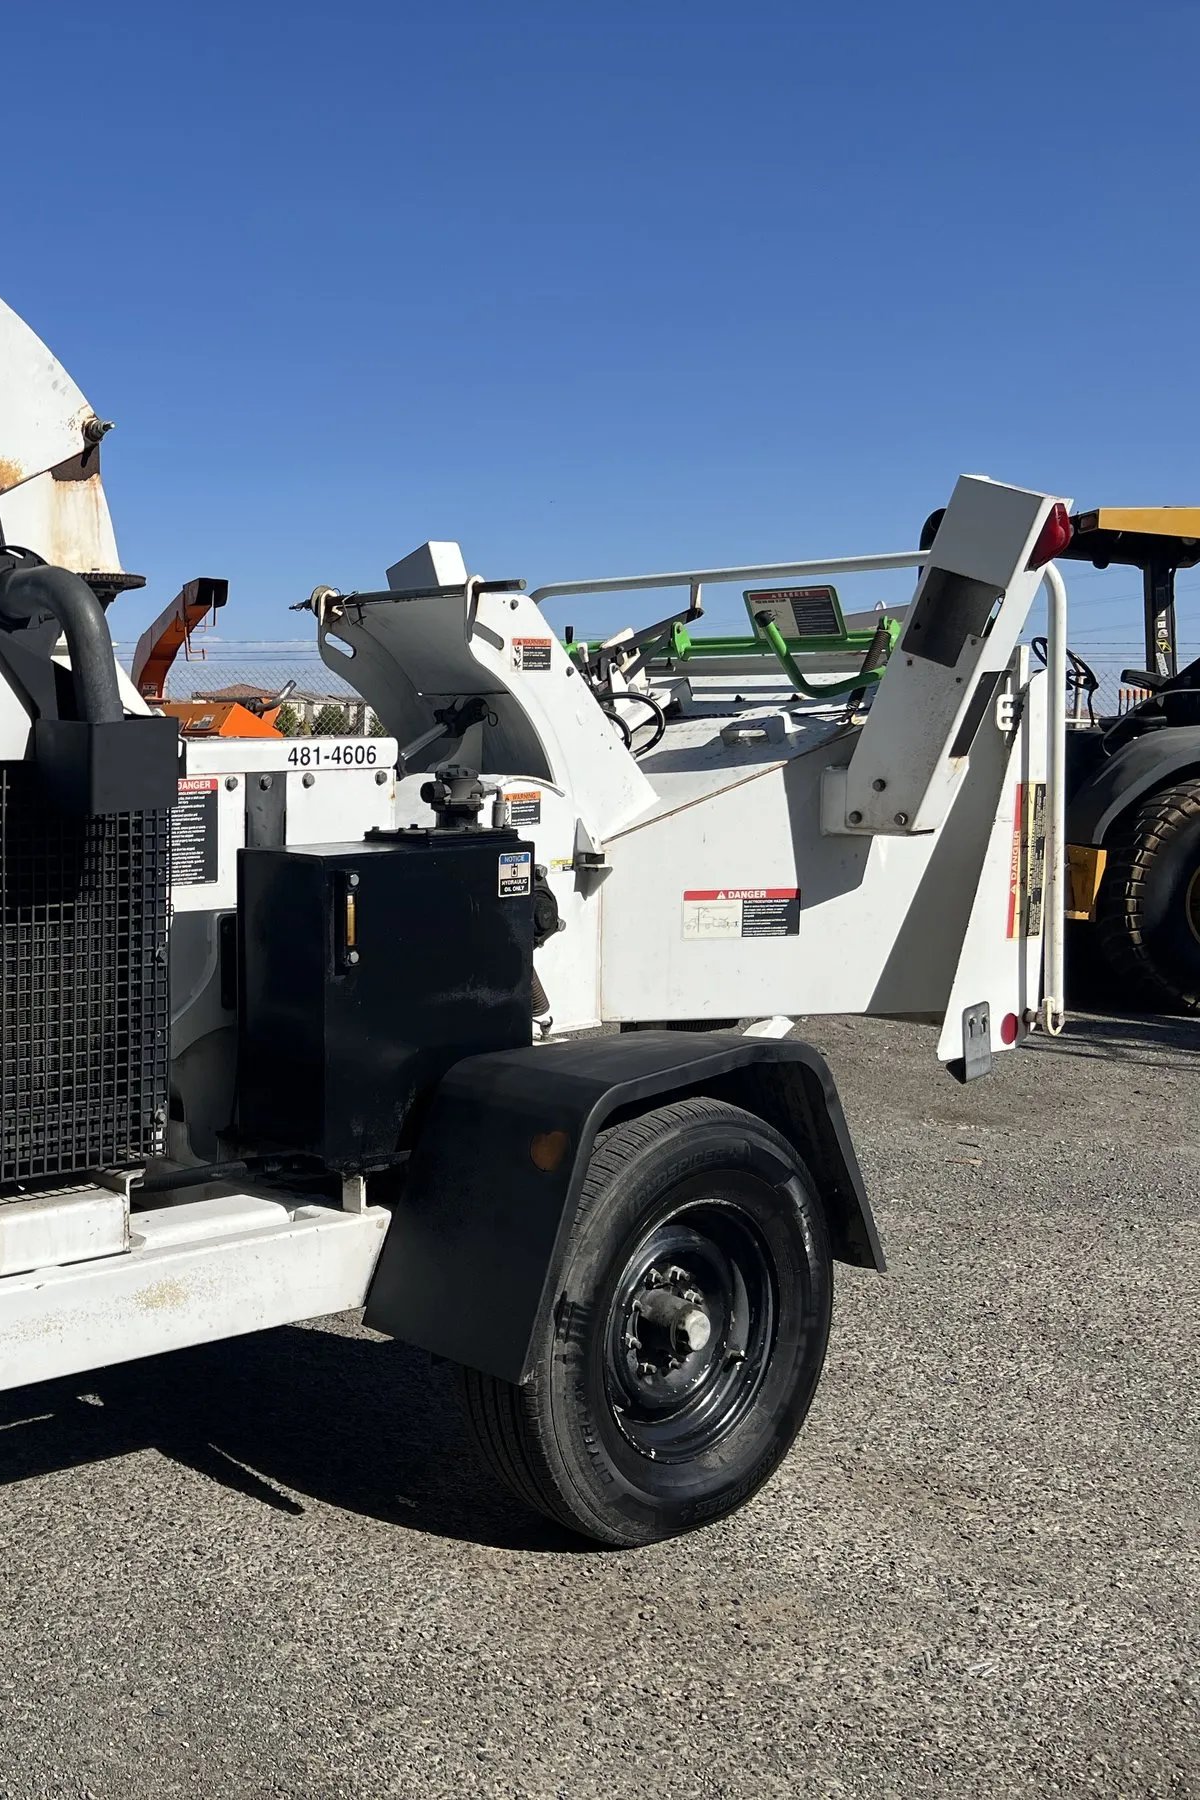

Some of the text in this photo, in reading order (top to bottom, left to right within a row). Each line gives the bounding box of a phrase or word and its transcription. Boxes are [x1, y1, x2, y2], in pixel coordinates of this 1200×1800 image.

[288, 745, 377, 766] 481-4606
[512, 792, 536, 800] WARNING
[504, 855, 525, 863] NOTICE
[1010, 830, 1020, 881] DANGER
[728, 890, 767, 899] DANGER
